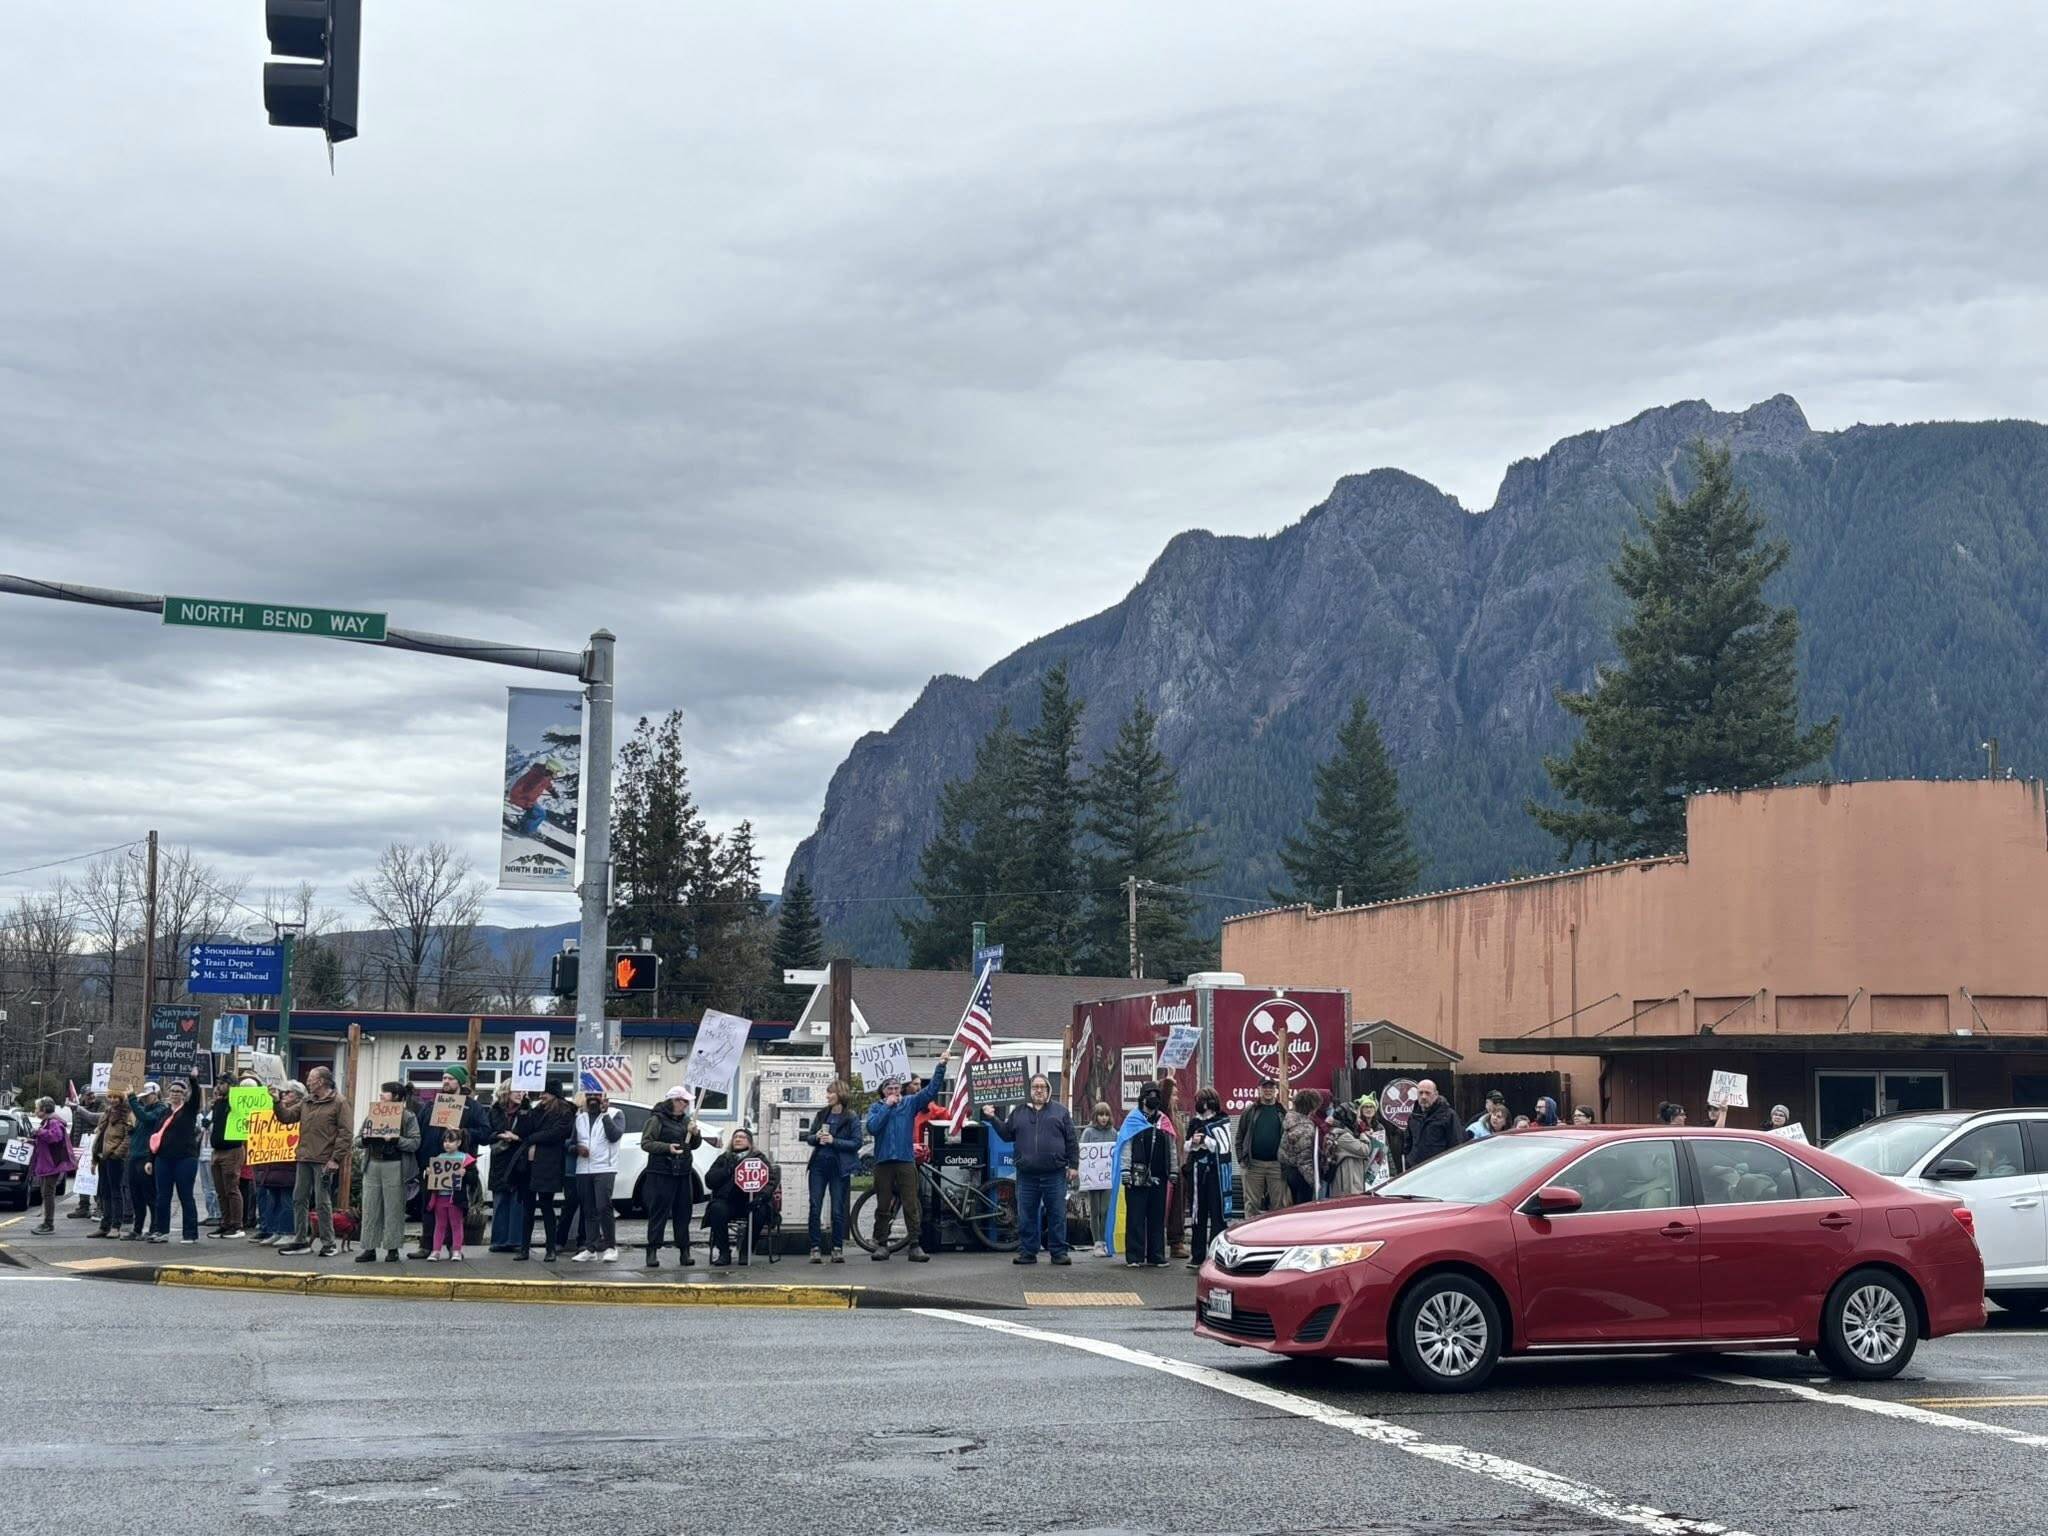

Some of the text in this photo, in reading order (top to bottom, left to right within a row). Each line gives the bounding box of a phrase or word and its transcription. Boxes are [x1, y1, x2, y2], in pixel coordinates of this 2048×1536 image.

[181, 603, 369, 633] NORTH BEND WAY
[504, 865, 554, 874] NORTH BEND
[204, 946, 275, 957] Snoqualmie Falls
[204, 958, 254, 969] Train Depot
[203, 970, 269, 980] Mt. Si Trailhead
[1150, 999, 1192, 1026] Cascadia
[401, 1044, 412, 1060] A
[417, 1044, 431, 1060] &
[435, 1044, 446, 1060] P
[520, 1037, 546, 1056] NO
[860, 1040, 904, 1065] JUST SAY
[518, 1059, 543, 1077] ICE
[579, 1056, 625, 1070] RESIST
[875, 1059, 894, 1078] NO
[987, 1060, 1023, 1070] BELIEVE
[1124, 1059, 1153, 1076] GETTING
[1262, 1062, 1280, 1076] PIZZ
[96, 1067, 111, 1077] IC
[865, 1080, 877, 1089] TO
[237, 1094, 267, 1109] PROUD
[268, 1136, 284, 1150] YOU
[8, 1144, 20, 1159] ICE
[18, 1142, 30, 1162] OUT
[432, 1160, 461, 1174] BOO
[944, 1156, 978, 1166] Garbage
[434, 1174, 462, 1190] ICE
[737, 1169, 767, 1181] STOP
[1084, 1174, 1092, 1182] A
